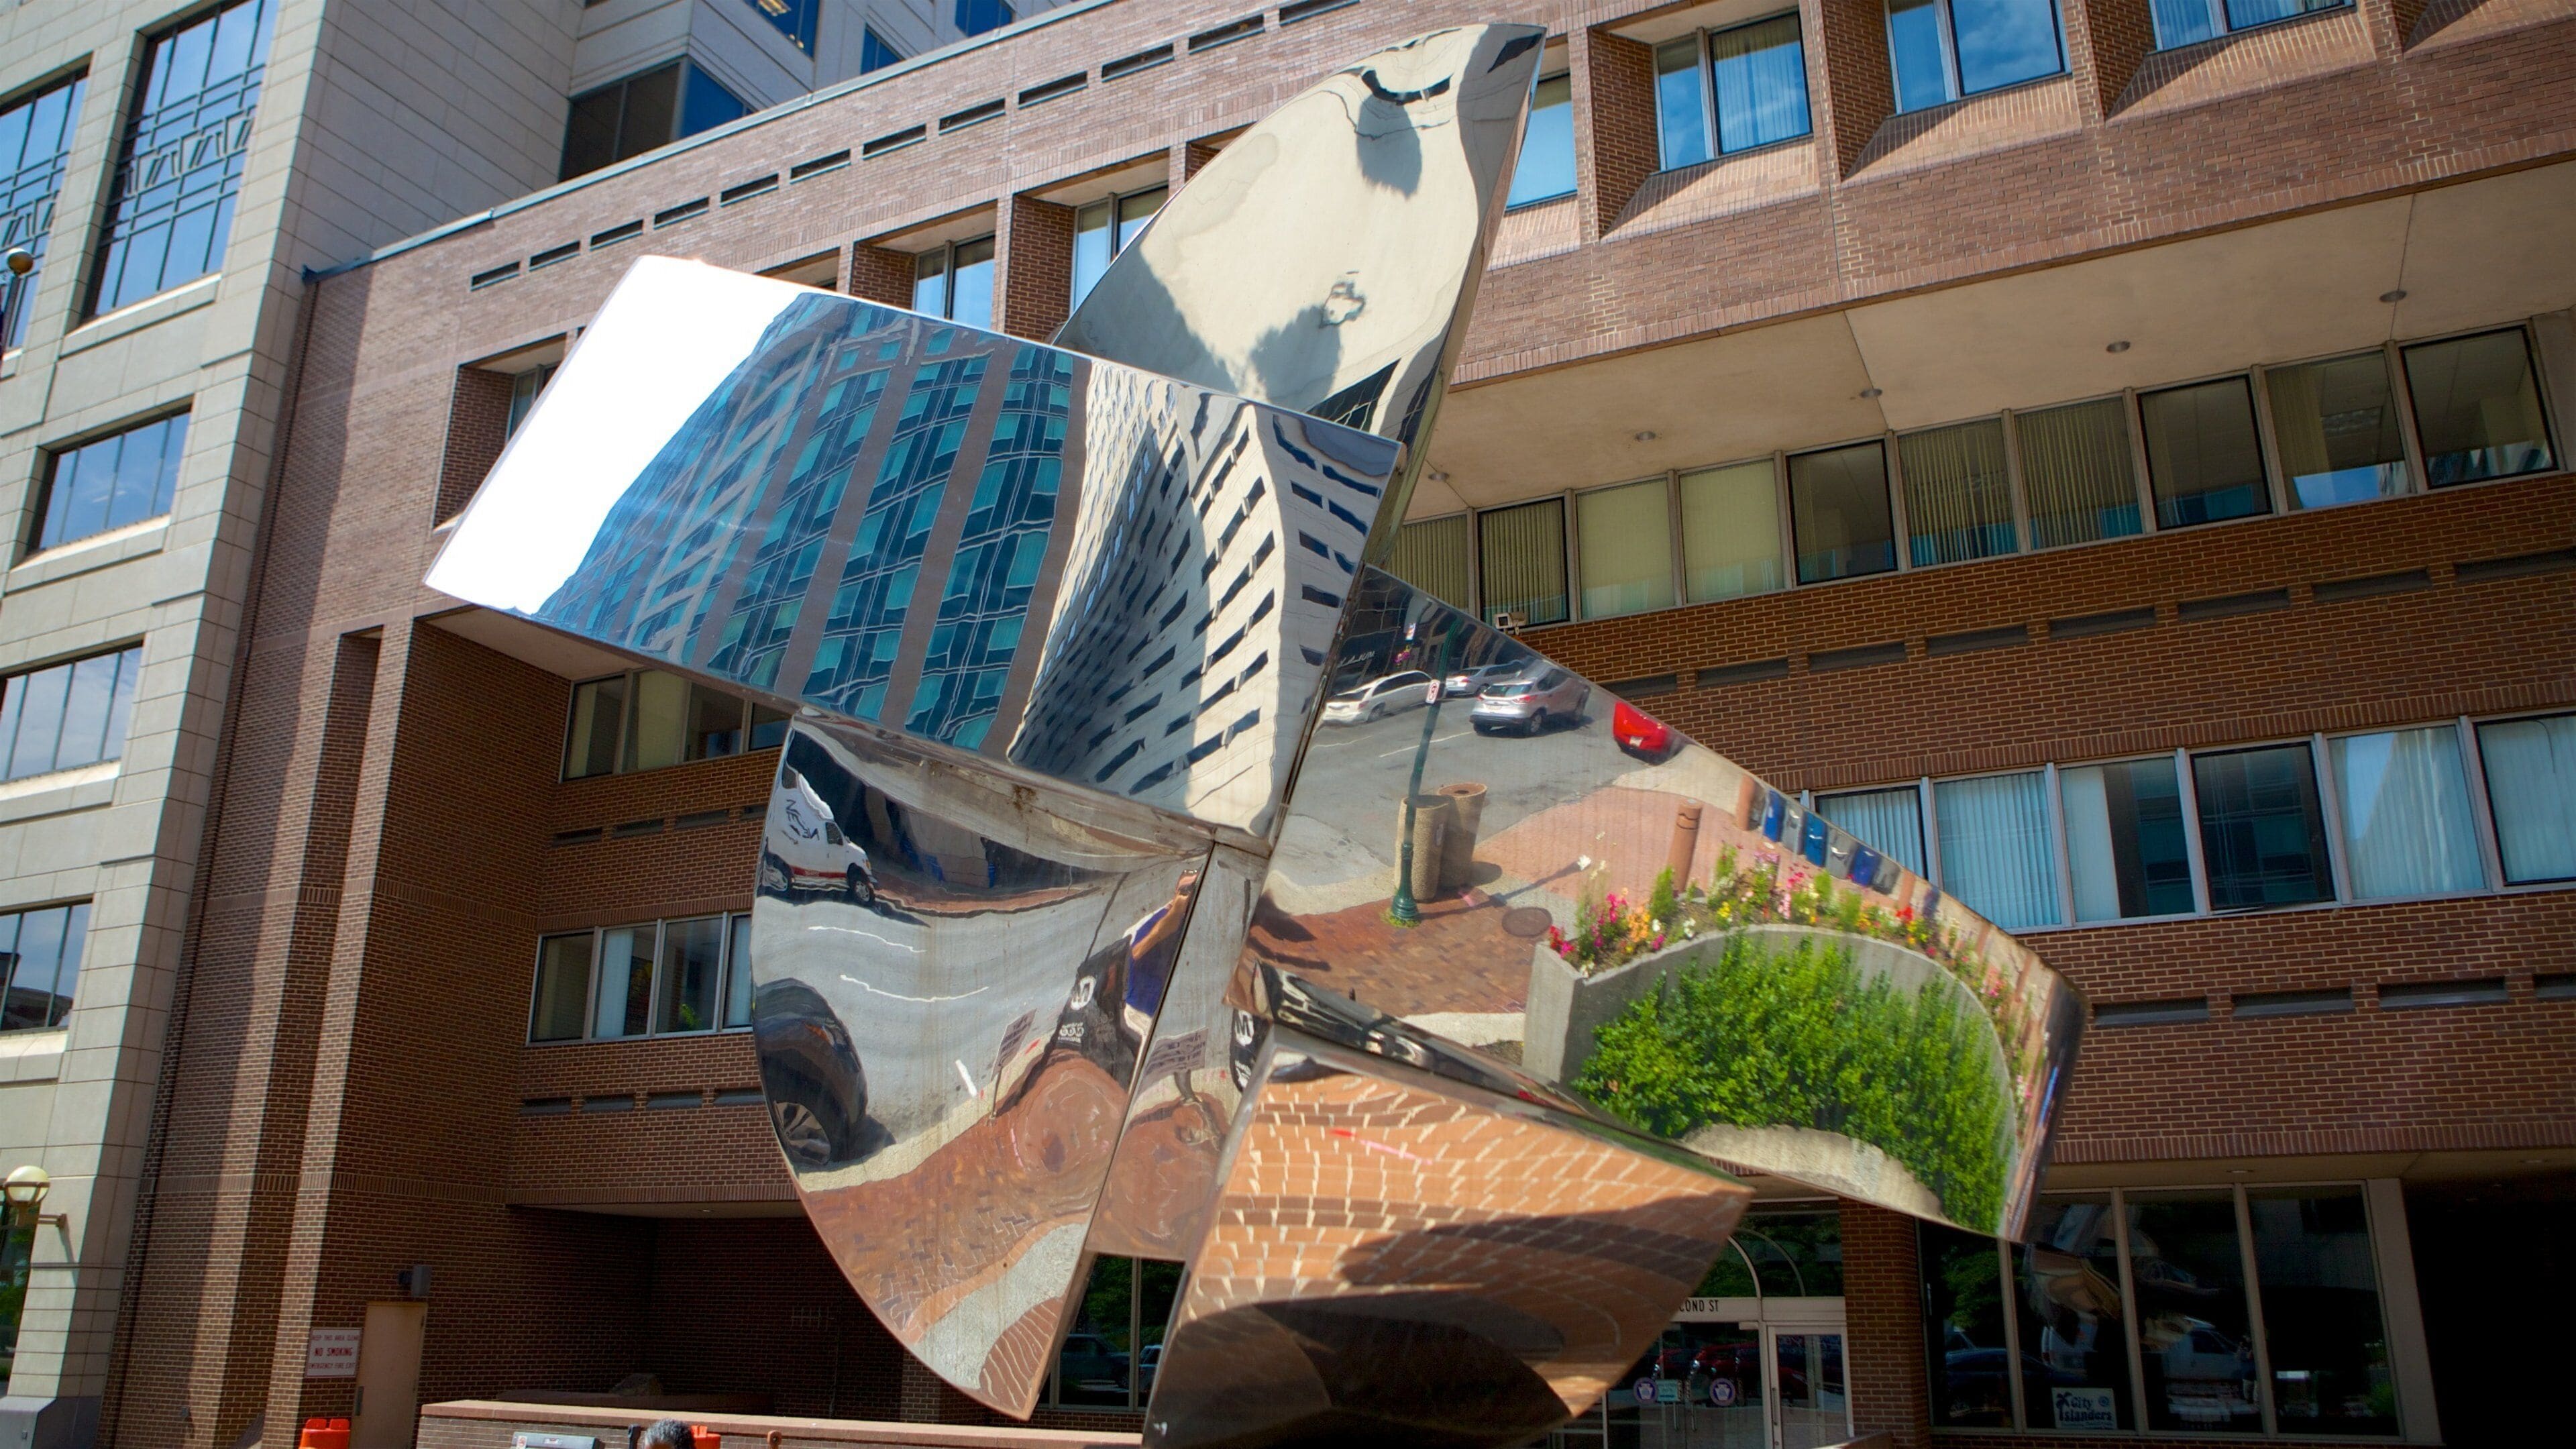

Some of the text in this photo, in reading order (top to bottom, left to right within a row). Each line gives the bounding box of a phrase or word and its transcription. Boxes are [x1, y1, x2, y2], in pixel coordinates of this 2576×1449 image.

[1709, 1299, 1719, 1311] ST
[315, 1347, 353, 1356] NO SMOKING
[2071, 1395, 2093, 1410] City
[2059, 1409, 2112, 1421] Islanders
